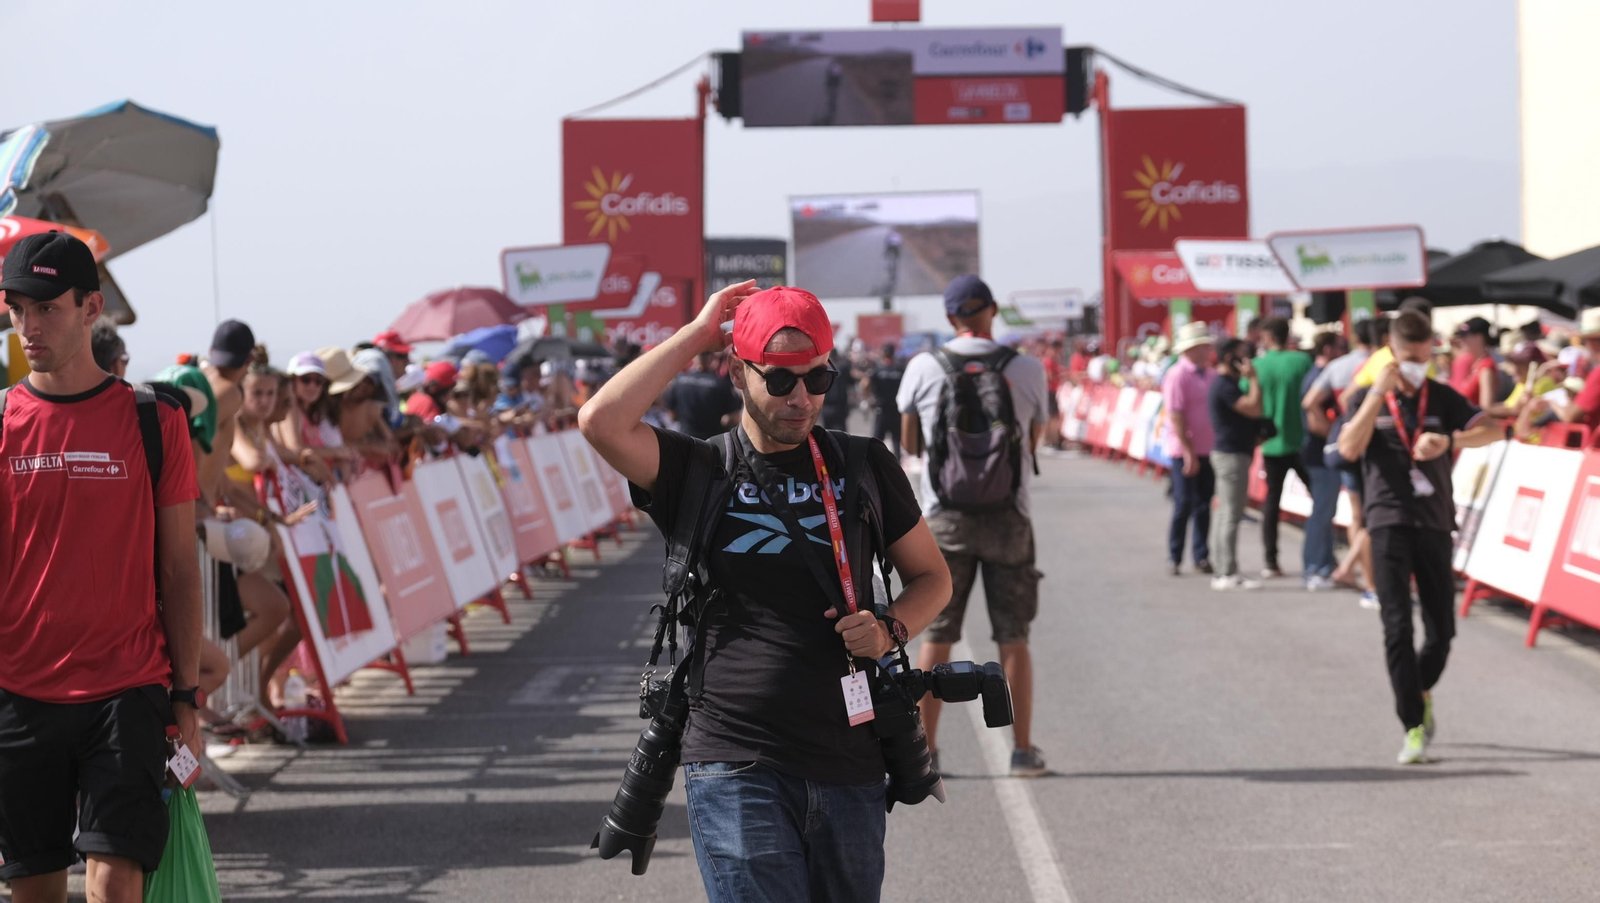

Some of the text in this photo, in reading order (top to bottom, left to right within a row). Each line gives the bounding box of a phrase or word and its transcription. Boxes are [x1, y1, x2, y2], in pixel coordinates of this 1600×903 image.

[1150, 180, 1240, 204] Cofidis
[601, 192, 688, 216] Cofidis
[1225, 253, 1281, 268] TISSO
[15, 456, 63, 471] LA VUELTA
[72, 465, 105, 473] Carrefour
